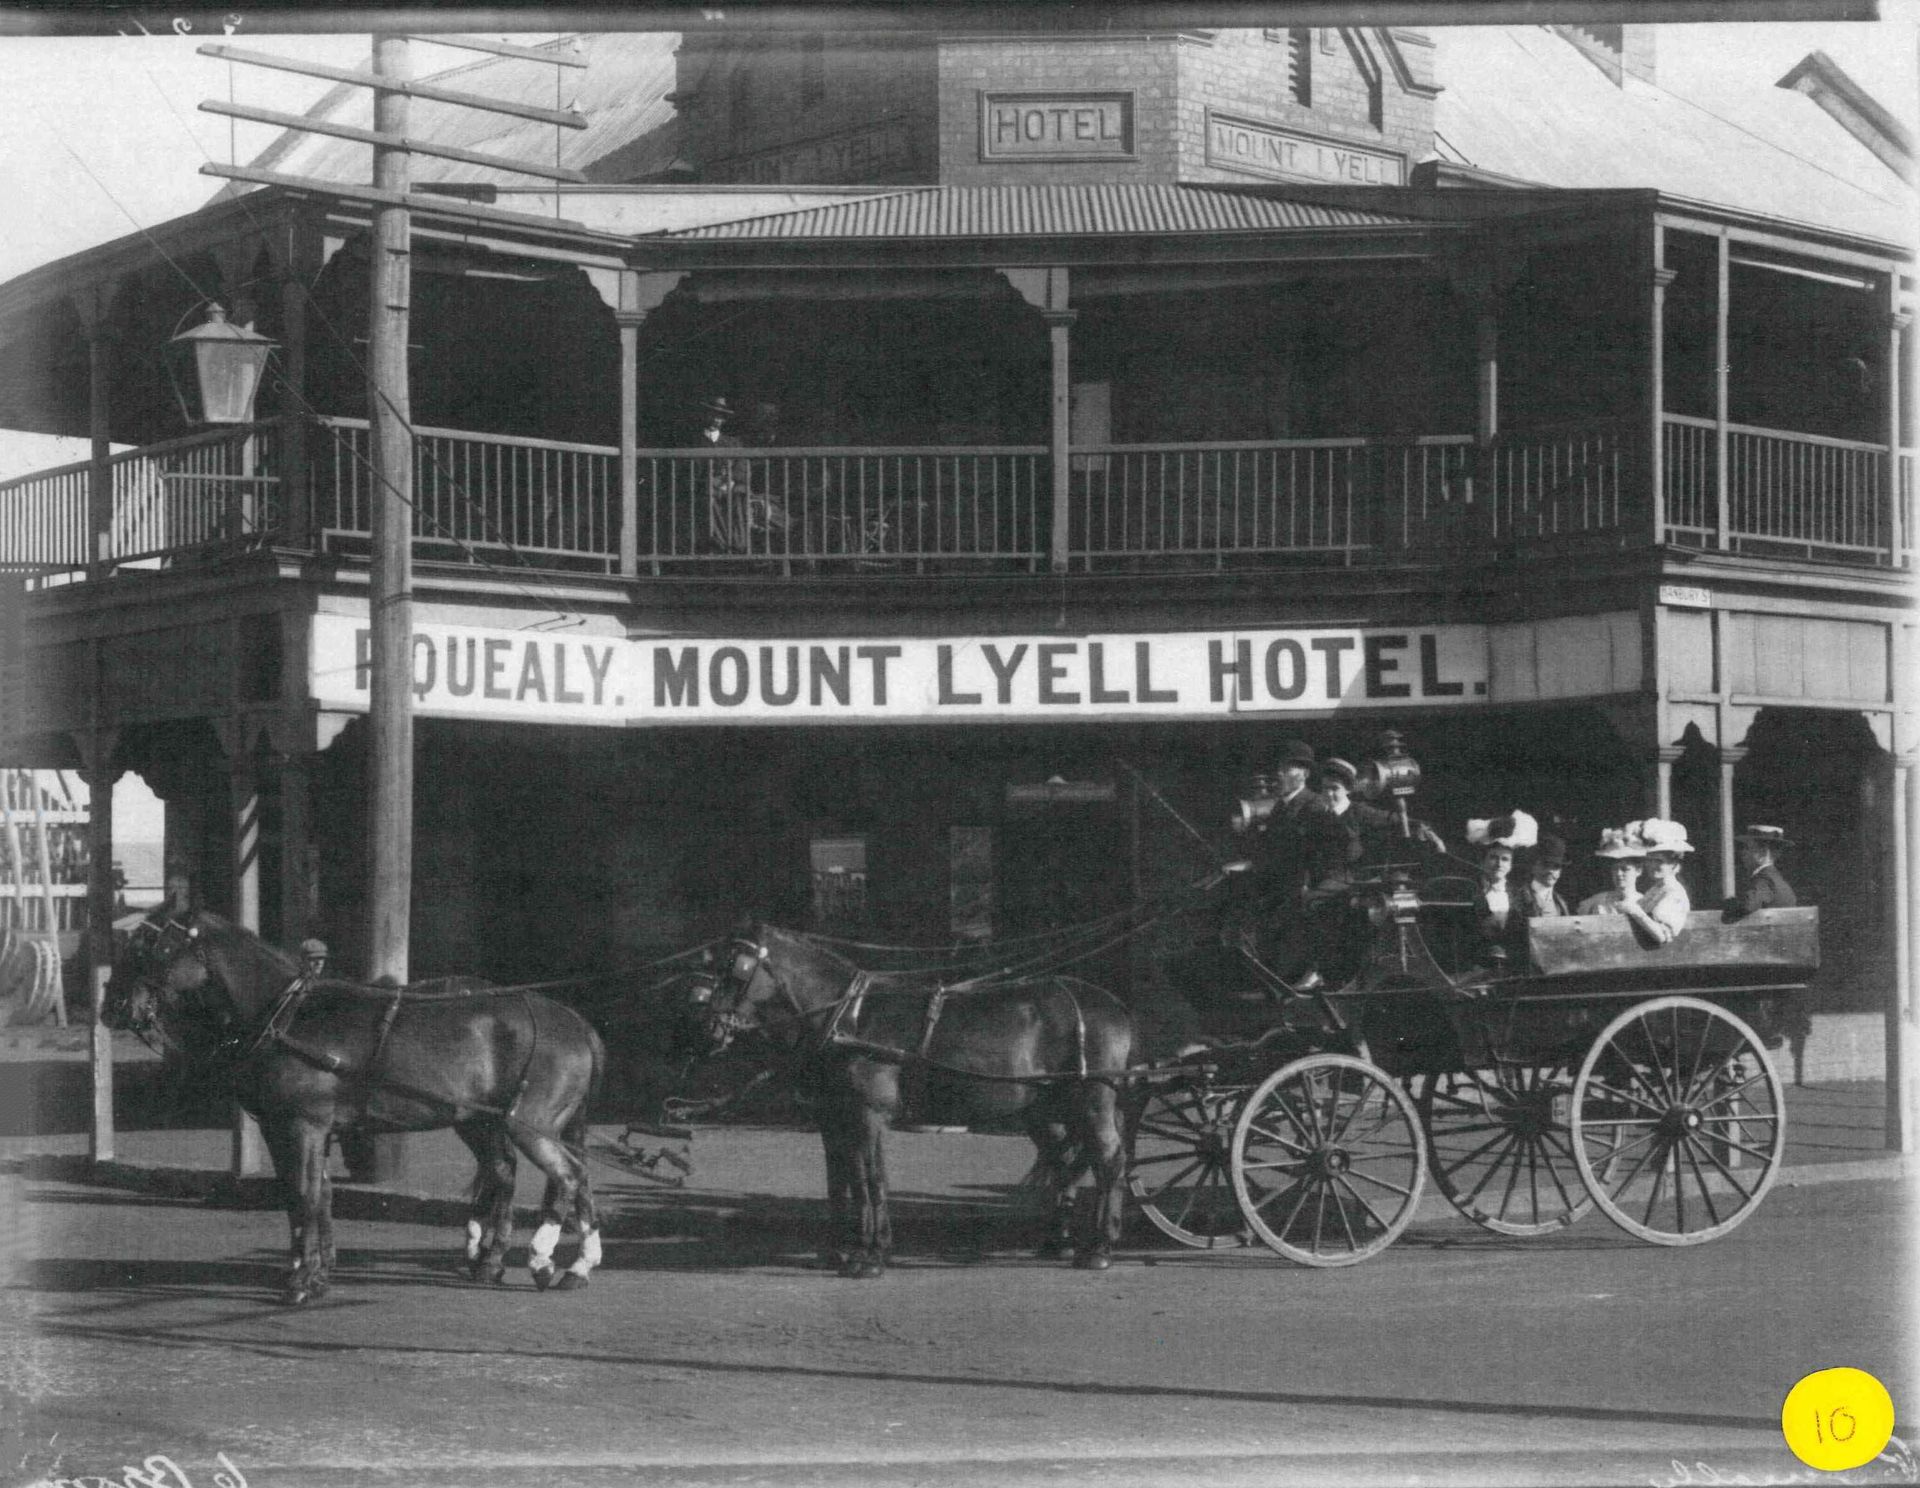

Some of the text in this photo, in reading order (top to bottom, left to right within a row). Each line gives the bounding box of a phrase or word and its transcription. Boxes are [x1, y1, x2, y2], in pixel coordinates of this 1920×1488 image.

[997, 108, 1121, 143] HOTEL
[1216, 126, 1299, 169] MOUNT
[412, 632, 625, 706] QUEALY.
[653, 633, 1487, 707] MOUNT LYELL HOTEL.
